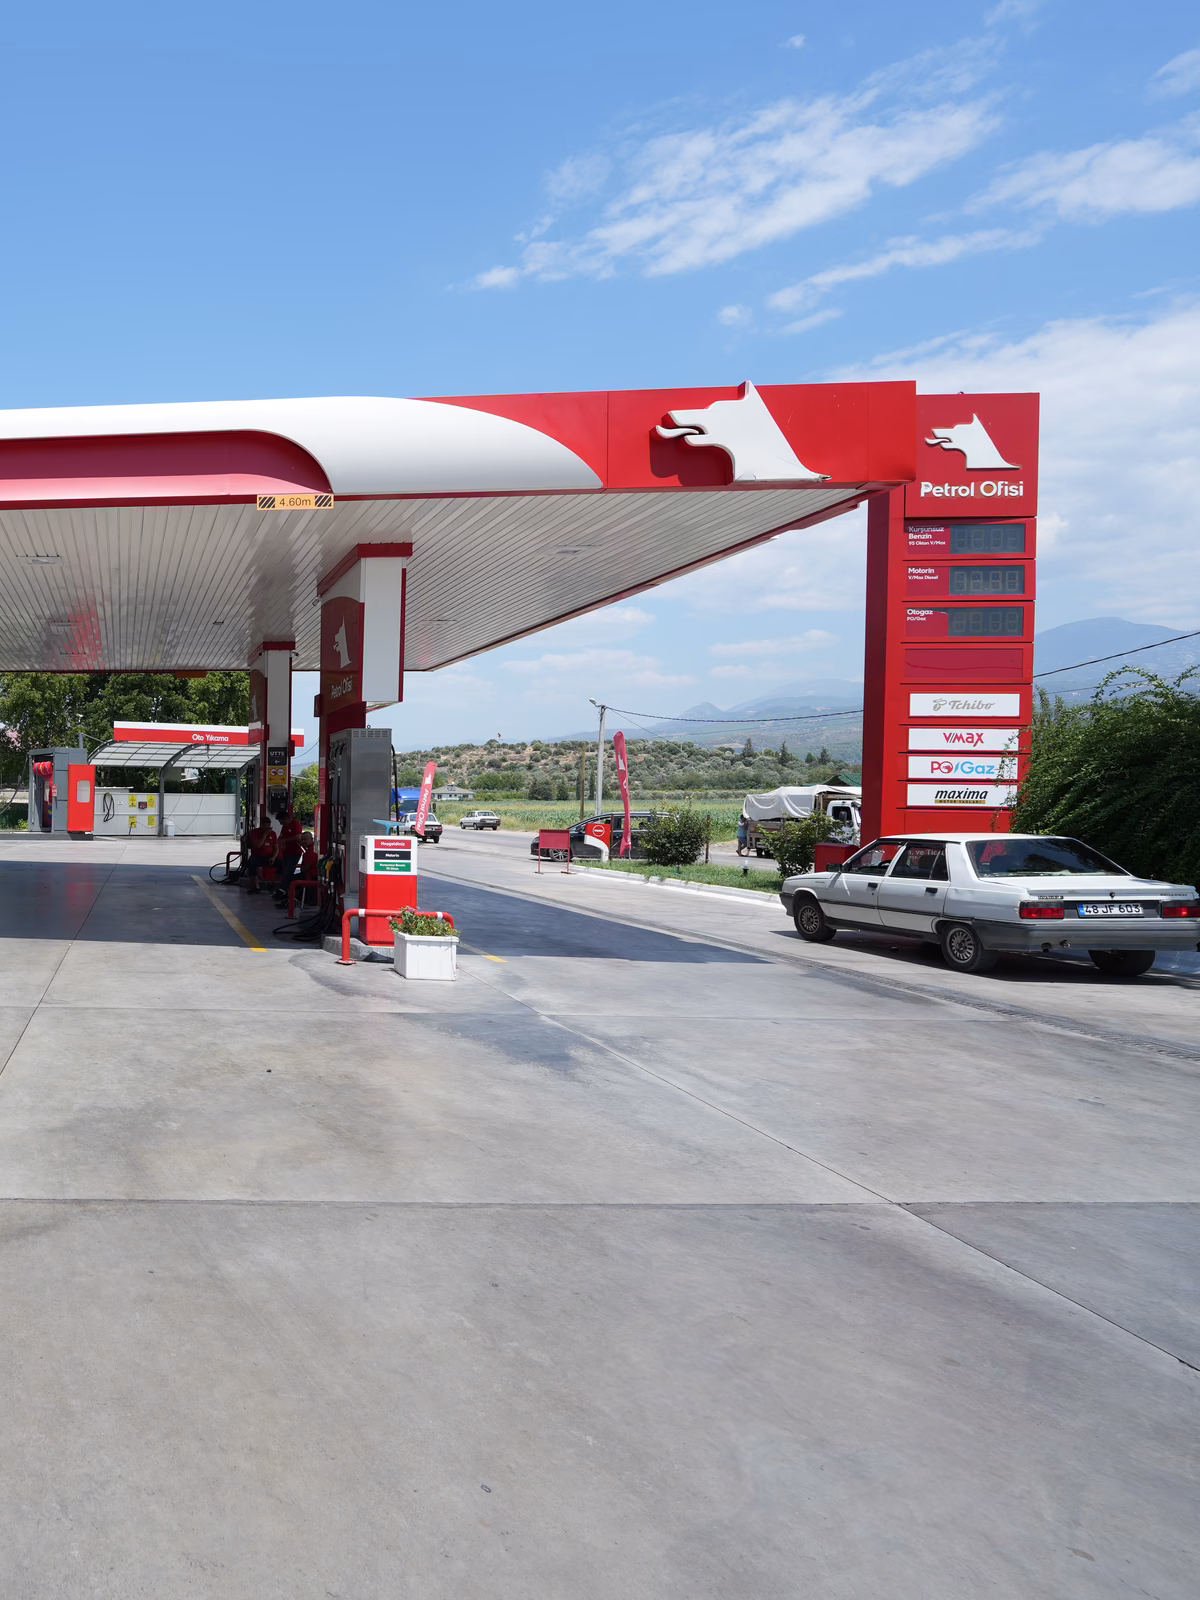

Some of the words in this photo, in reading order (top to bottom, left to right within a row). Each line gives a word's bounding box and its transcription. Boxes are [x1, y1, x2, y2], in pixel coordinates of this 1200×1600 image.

[920, 481, 975, 497] Petrol
[979, 480, 1024, 497] Ofisi
[279, 497, 312, 507] 4.60m
[908, 525, 945, 534] Kurşunsuz
[906, 608, 934, 617] Otogaz
[330, 681, 343, 700] Petrol
[342, 675, 353, 694] Ofisi
[948, 700, 996, 711] Tchibo
[191, 733, 205, 741] Oto
[934, 787, 989, 800] maxima
[420, 788, 430, 811] Petrol
[1085, 904, 1099, 914] 48
[1101, 904, 1115, 914] JF
[1118, 904, 1141, 913] 603
